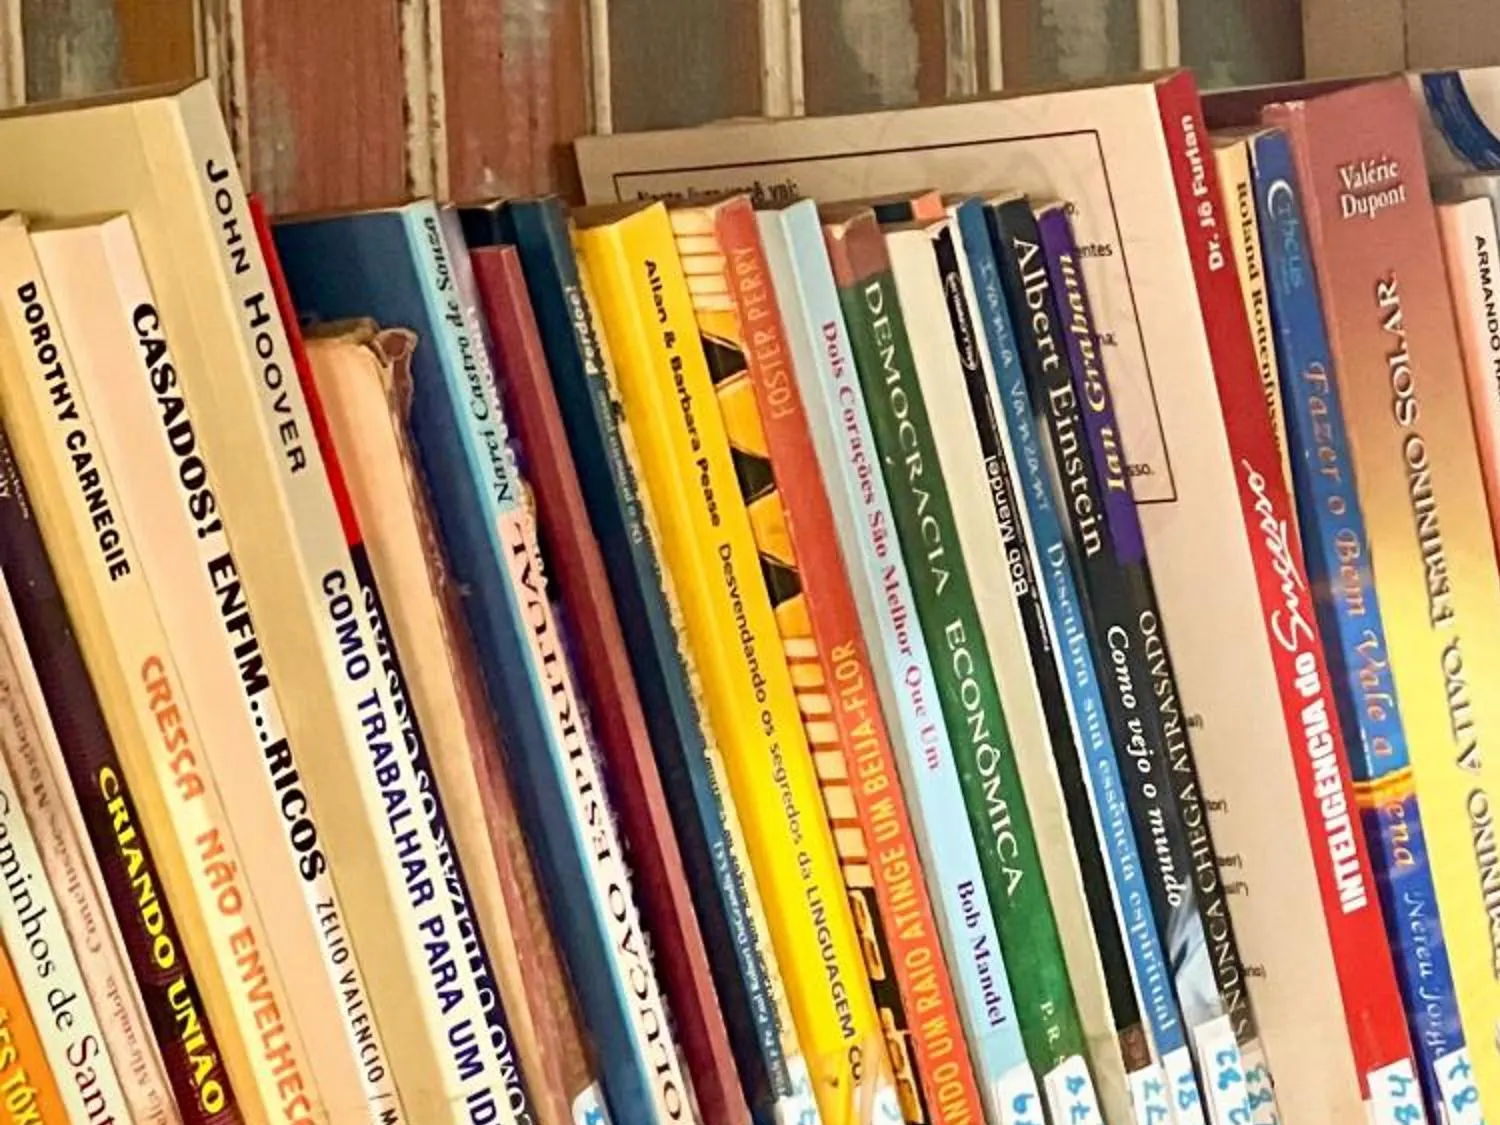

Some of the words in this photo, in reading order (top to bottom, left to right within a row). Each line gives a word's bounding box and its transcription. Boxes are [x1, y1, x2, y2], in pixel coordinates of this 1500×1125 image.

[1181, 114, 1209, 198] Furlan
[1339, 157, 1400, 190] Valérie
[1236, 181, 1259, 281] Roland
[1341, 186, 1407, 221] Dupont
[423, 216, 452, 292] Souza
[644, 259, 667, 325] Allan
[732, 246, 772, 321] PERRY
[1207, 234, 1225, 272] Dr.
[206, 159, 250, 275] JOHN
[244, 291, 306, 474] HOOVER
[443, 302, 466, 332] de
[565, 285, 598, 376] Perdoe!
[663, 334, 677, 349] &
[1013, 237, 1059, 372] Albert
[1059, 255, 1106, 412] Graham
[1376, 271, 1421, 429] SOLAR
[452, 338, 489, 422] Castro
[669, 355, 700, 453] Barbara
[751, 328, 795, 420] FOSTER
[17, 281, 80, 422] DOROTHY
[66, 430, 131, 582] CARNEGIE
[132, 302, 222, 539] CASADOS!
[1099, 426, 1128, 491] Ian
[696, 456, 722, 527] Pease
[985, 455, 1016, 544] Mandel
[1049, 384, 1102, 558] Einstein
[1327, 494, 1346, 517] o
[1005, 545, 1029, 598] Bob
[1241, 460, 1317, 653] Sucesso
[1334, 530, 1366, 616] Bem
[1402, 432, 1455, 631] FEMININO
[717, 543, 767, 705] Desvendando
[864, 281, 952, 596] DEMOCRACIA
[944, 620, 1025, 897] ECONÔMICA
[508, 520, 613, 863] ESPIRITUAL
[821, 320, 844, 379] Dois
[838, 385, 874, 505] Corações
[868, 511, 888, 559] São
[881, 565, 913, 658] Melhor
[903, 667, 928, 719] Que
[920, 725, 941, 771] Um
[956, 879, 979, 929] Bob
[972, 935, 1007, 1027] Mandel
[1108, 625, 1136, 710] Como
[1139, 610, 1193, 772] ATRASADO
[1294, 653, 1318, 699] do
[1358, 630, 1394, 724] Vale
[761, 709, 775, 737] os
[830, 639, 890, 793] BEIJA-FLOR
[1127, 717, 1154, 774] vejo
[1374, 738, 1393, 757] a
[322, 569, 371, 682] COMO
[357, 687, 437, 908] TRABALHAR
[419, 914, 463, 1017] PARA
[448, 1020, 484, 1080] UM
[769, 742, 805, 848] segredos
[868, 800, 901, 845] UM
[1047, 542, 1088, 688] Descubra
[1098, 758, 1136, 882] essência
[1129, 890, 1178, 1033] espiritual
[1142, 782, 1157, 799] o
[1300, 697, 1368, 914] INTELIGÊNCIA
[196, 828, 243, 917] NÃO
[797, 851, 813, 880] da
[1148, 806, 1182, 908] mundo
[1180, 783, 1217, 894] CHEGA
[879, 846, 926, 940] ATINGE
[1404, 893, 1435, 981] Nereu
[99, 767, 175, 970] CRIANDO
[167, 979, 224, 1115] UNIÃO
[804, 883, 856, 1040] LINGUAGEM
[905, 948, 943, 1016] RAIO
[1206, 900, 1241, 1012] NUNCA
[48, 987, 77, 1032] de
[316, 898, 350, 966] ZELIO
[339, 972, 386, 1084] VALENCIO
[922, 1020, 954, 1053] UM
